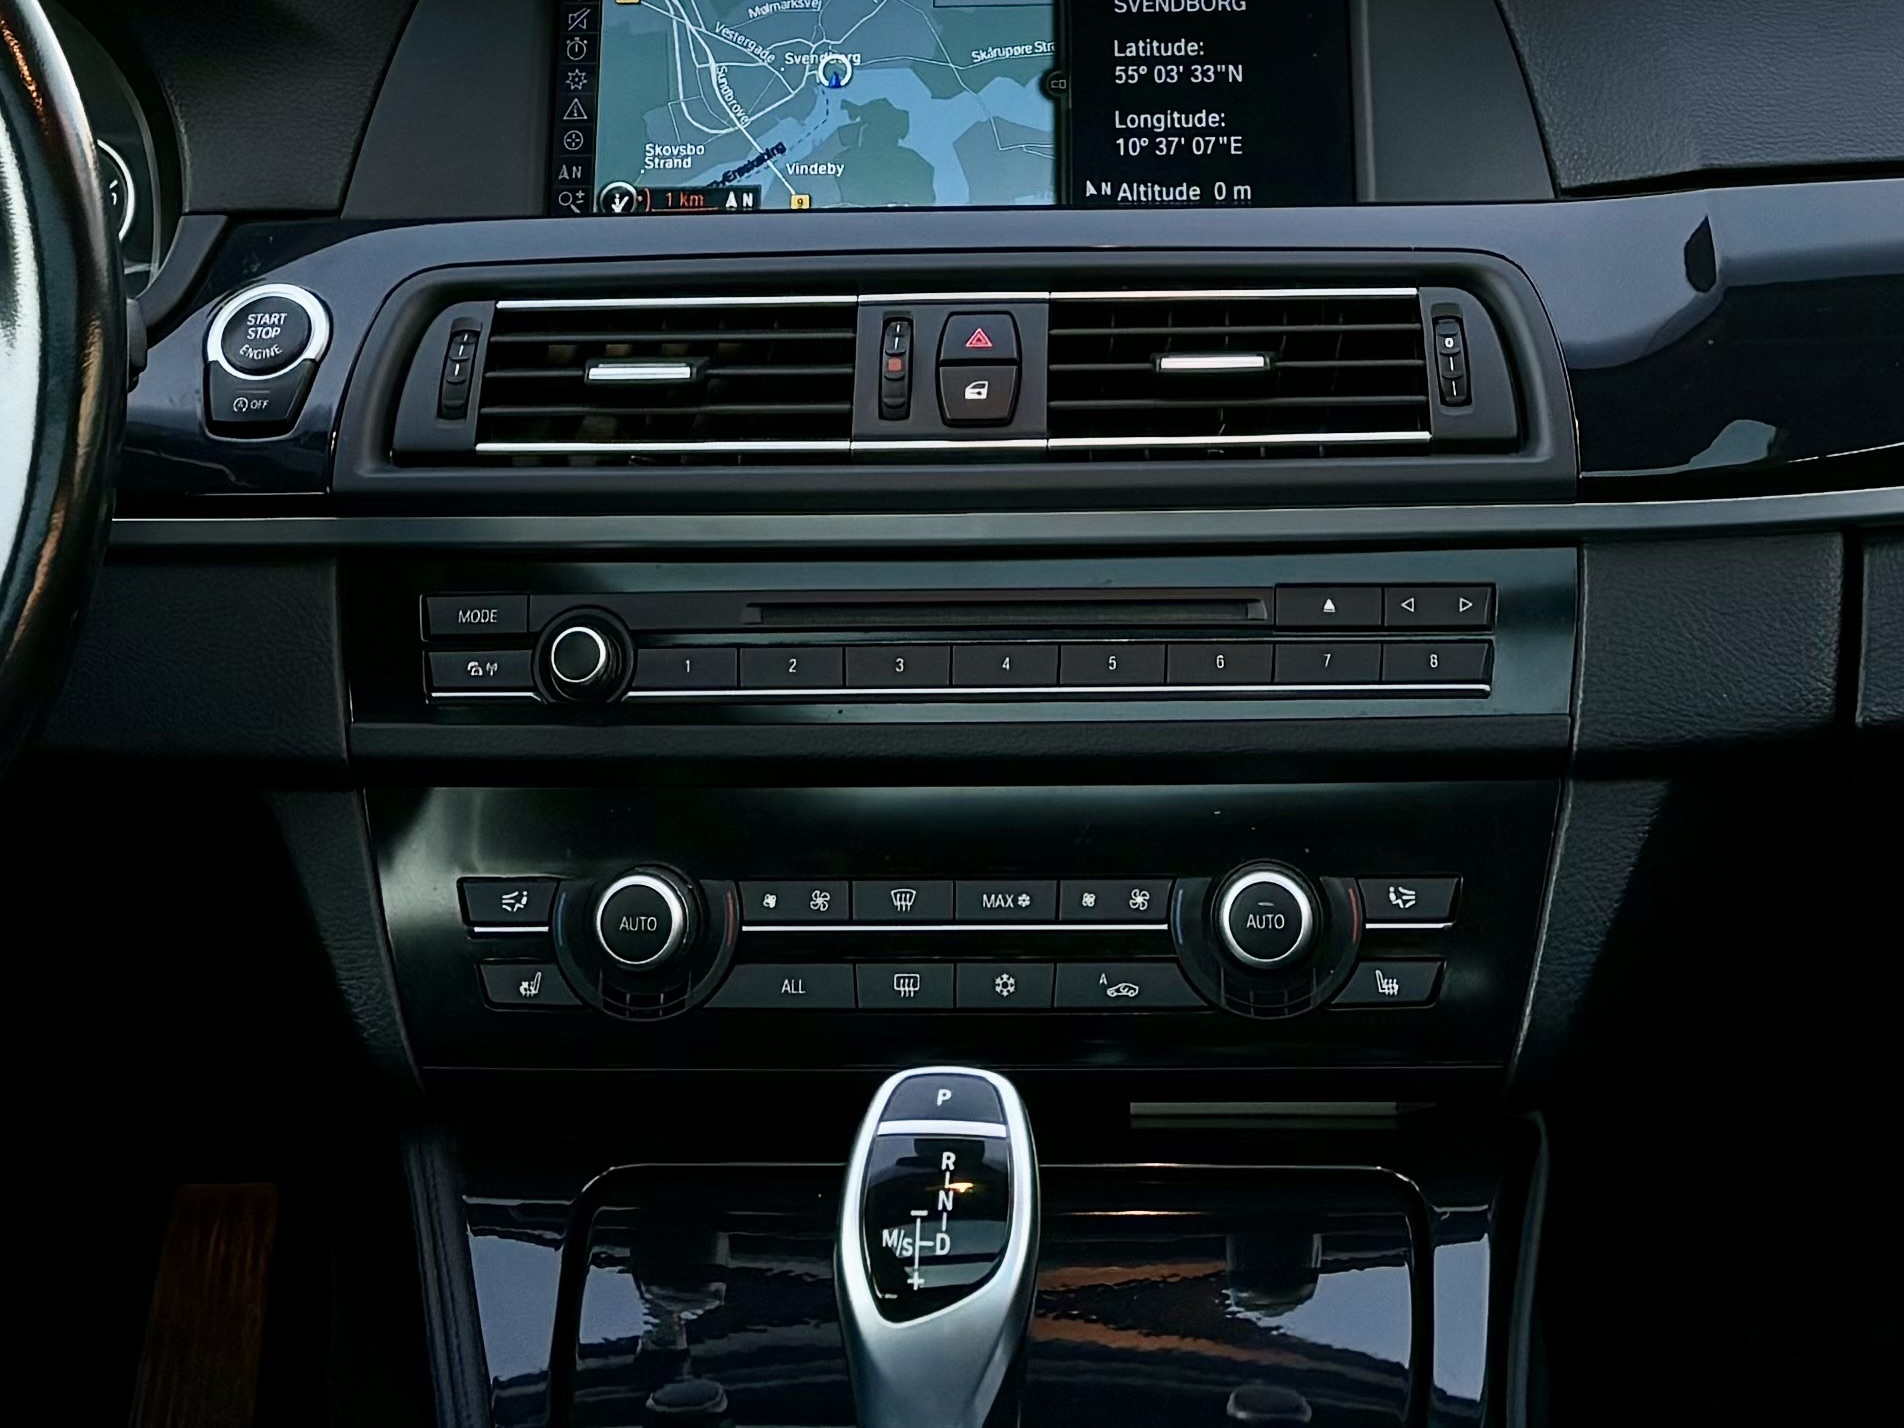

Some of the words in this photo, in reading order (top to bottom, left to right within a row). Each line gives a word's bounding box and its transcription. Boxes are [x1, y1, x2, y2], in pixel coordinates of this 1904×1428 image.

[715, 21, 776, 63] Vestergade
[1114, 39, 1205, 57] Latitude:
[1154, 65, 1184, 83] 03'
[1114, 109, 1226, 132] Longitude:
[645, 143, 705, 156] Skovsbo
[1155, 137, 1185, 155] 37'
[645, 156, 692, 169] Strand
[785, 161, 845, 176] Vindeby
[1117, 182, 1201, 201] Altitude
[1214, 181, 1227, 200] 0
[1233, 184, 1252, 200] m
[665, 192, 672, 207] 1
[679, 192, 705, 207] km
[796, 198, 804, 208] 9
[246, 312, 287, 325] START
[246, 326, 281, 340] STOP
[239, 344, 283, 360] ENGINE
[250, 399, 270, 410] OFF
[457, 609, 499, 624] MODE
[684, 660, 691, 673] 1
[788, 659, 797, 673] 2
[895, 658, 905, 672] 3
[1002, 657, 1011, 671] 4
[1108, 655, 1117, 670] 5
[1216, 654, 1225, 669] 6
[1323, 653, 1332, 668] 7
[1429, 653, 1438, 668] 8
[982, 894, 1014, 909] MAX
[619, 916, 658, 932] AUTO
[1246, 913, 1285, 930] AUTO
[781, 978, 806, 994] ALL
[936, 1088, 952, 1106] P
[941, 1151, 957, 1171] R
[937, 1190, 954, 1211] N
[882, 1228, 914, 1259] M/S
[935, 1232, 951, 1256] D
